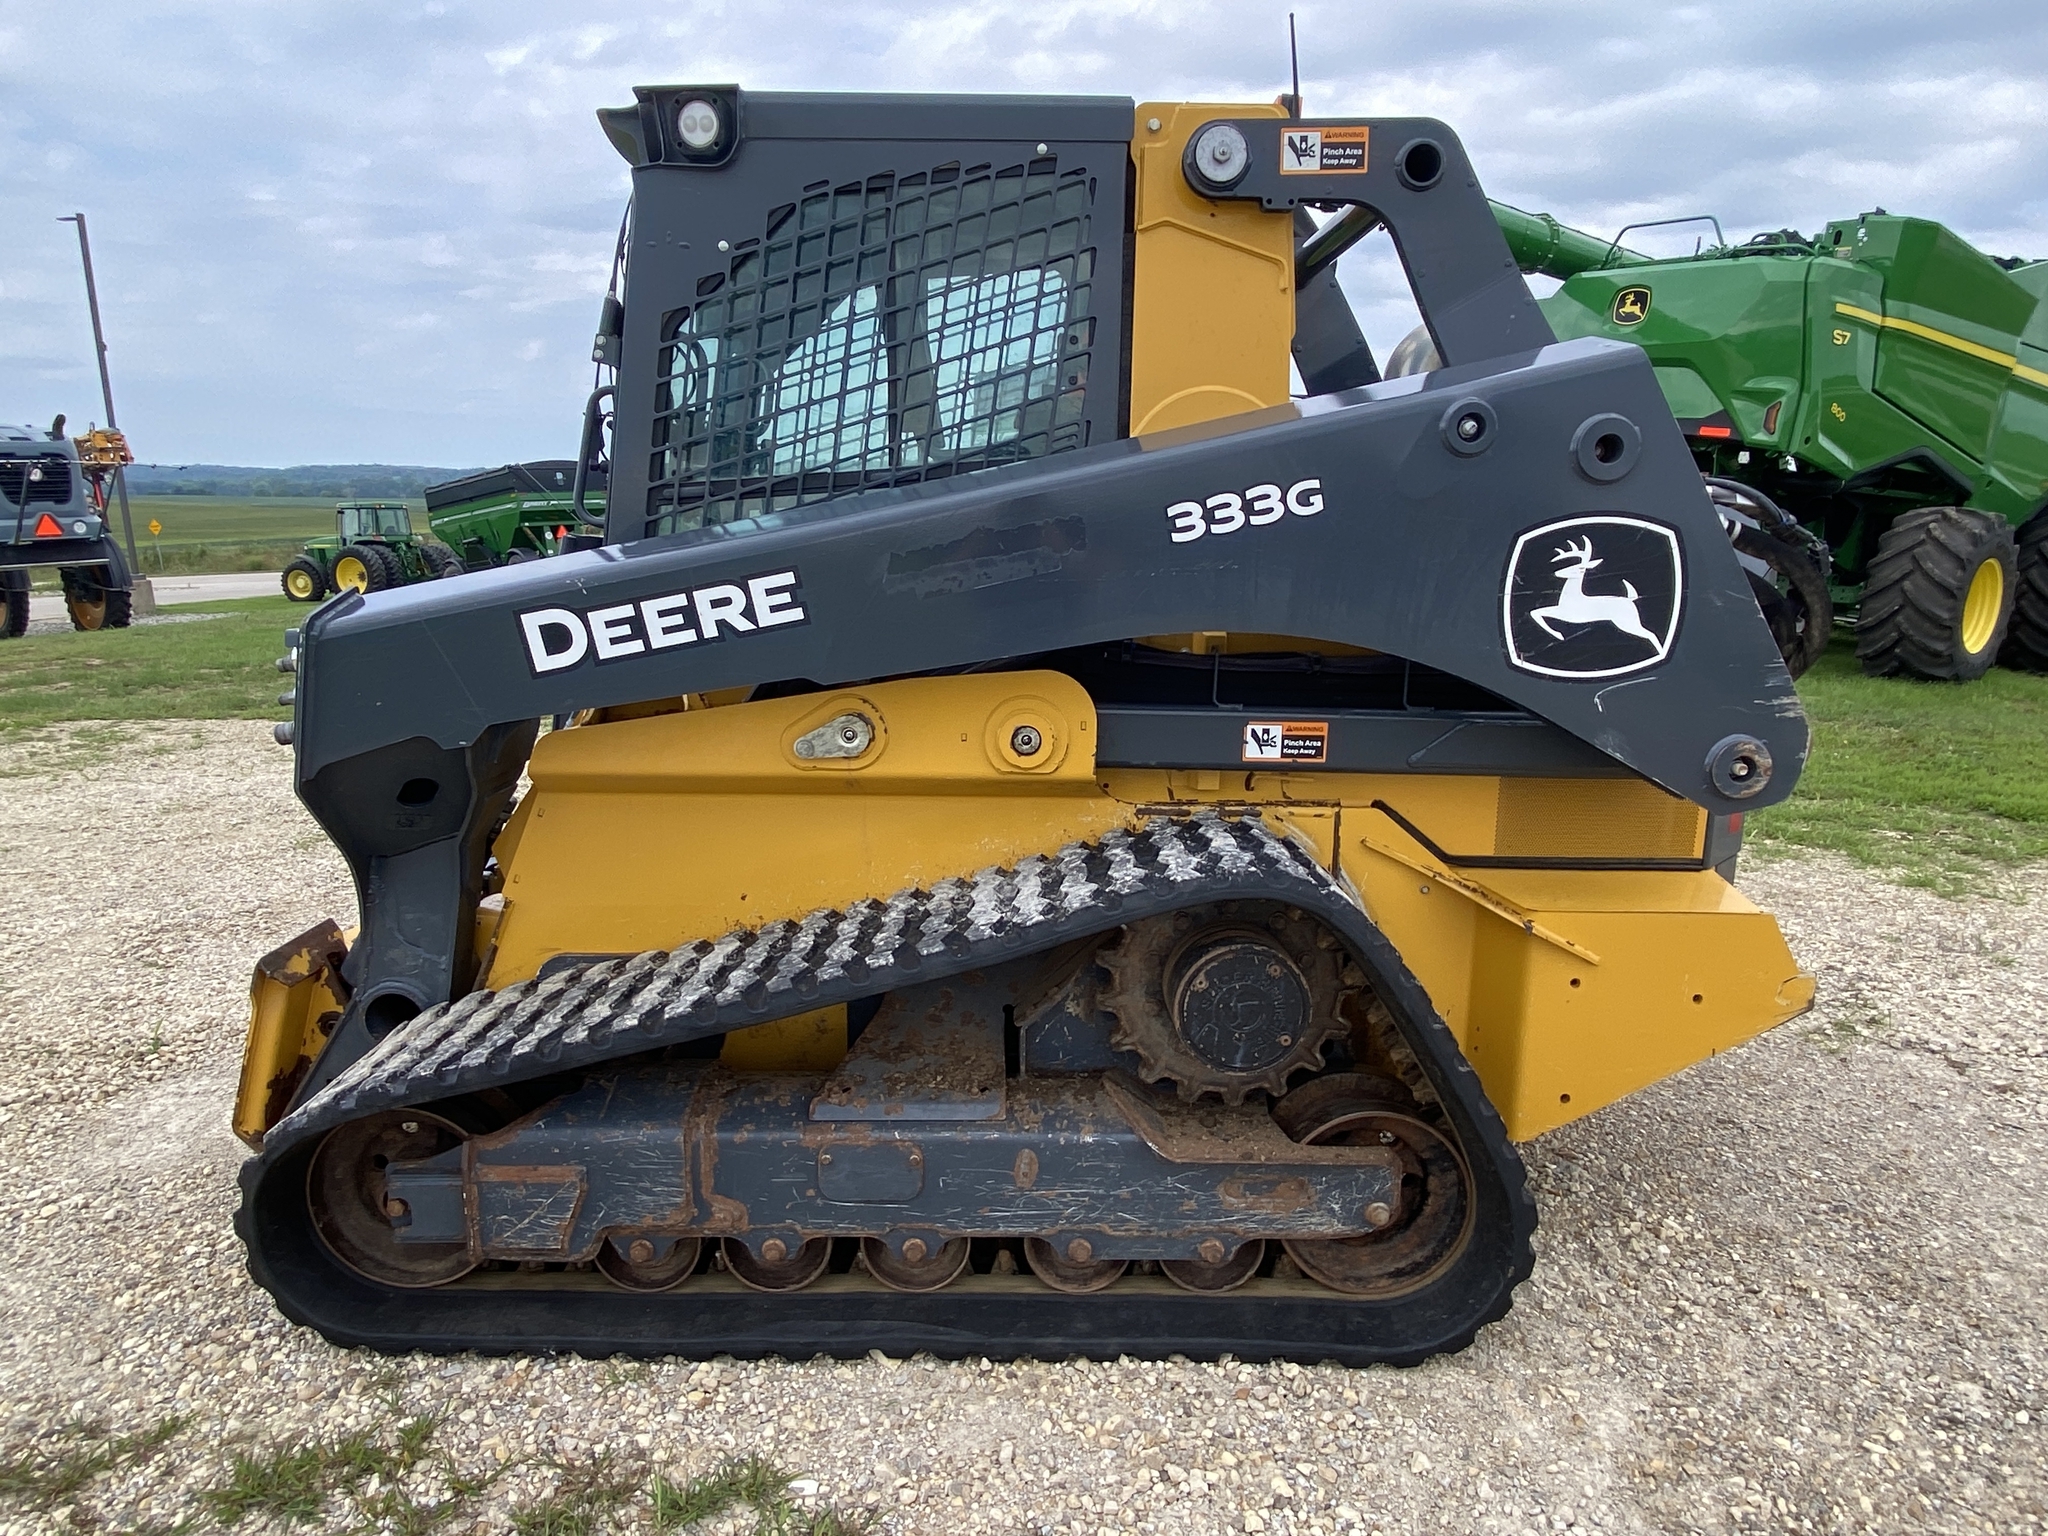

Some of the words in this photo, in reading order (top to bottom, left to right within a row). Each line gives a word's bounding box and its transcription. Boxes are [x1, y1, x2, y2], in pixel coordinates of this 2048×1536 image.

[1332, 131, 1364, 139] WARNING
[1323, 147, 1344, 155] Pinch
[1345, 147, 1362, 155] Area
[1833, 329, 1851, 345] S7
[1831, 402, 1846, 422] 800
[1166, 478, 1324, 543] 333G
[520, 571, 805, 673] DEERE
[1283, 739, 1304, 747] Pinch
[1305, 739, 1321, 747] Area
